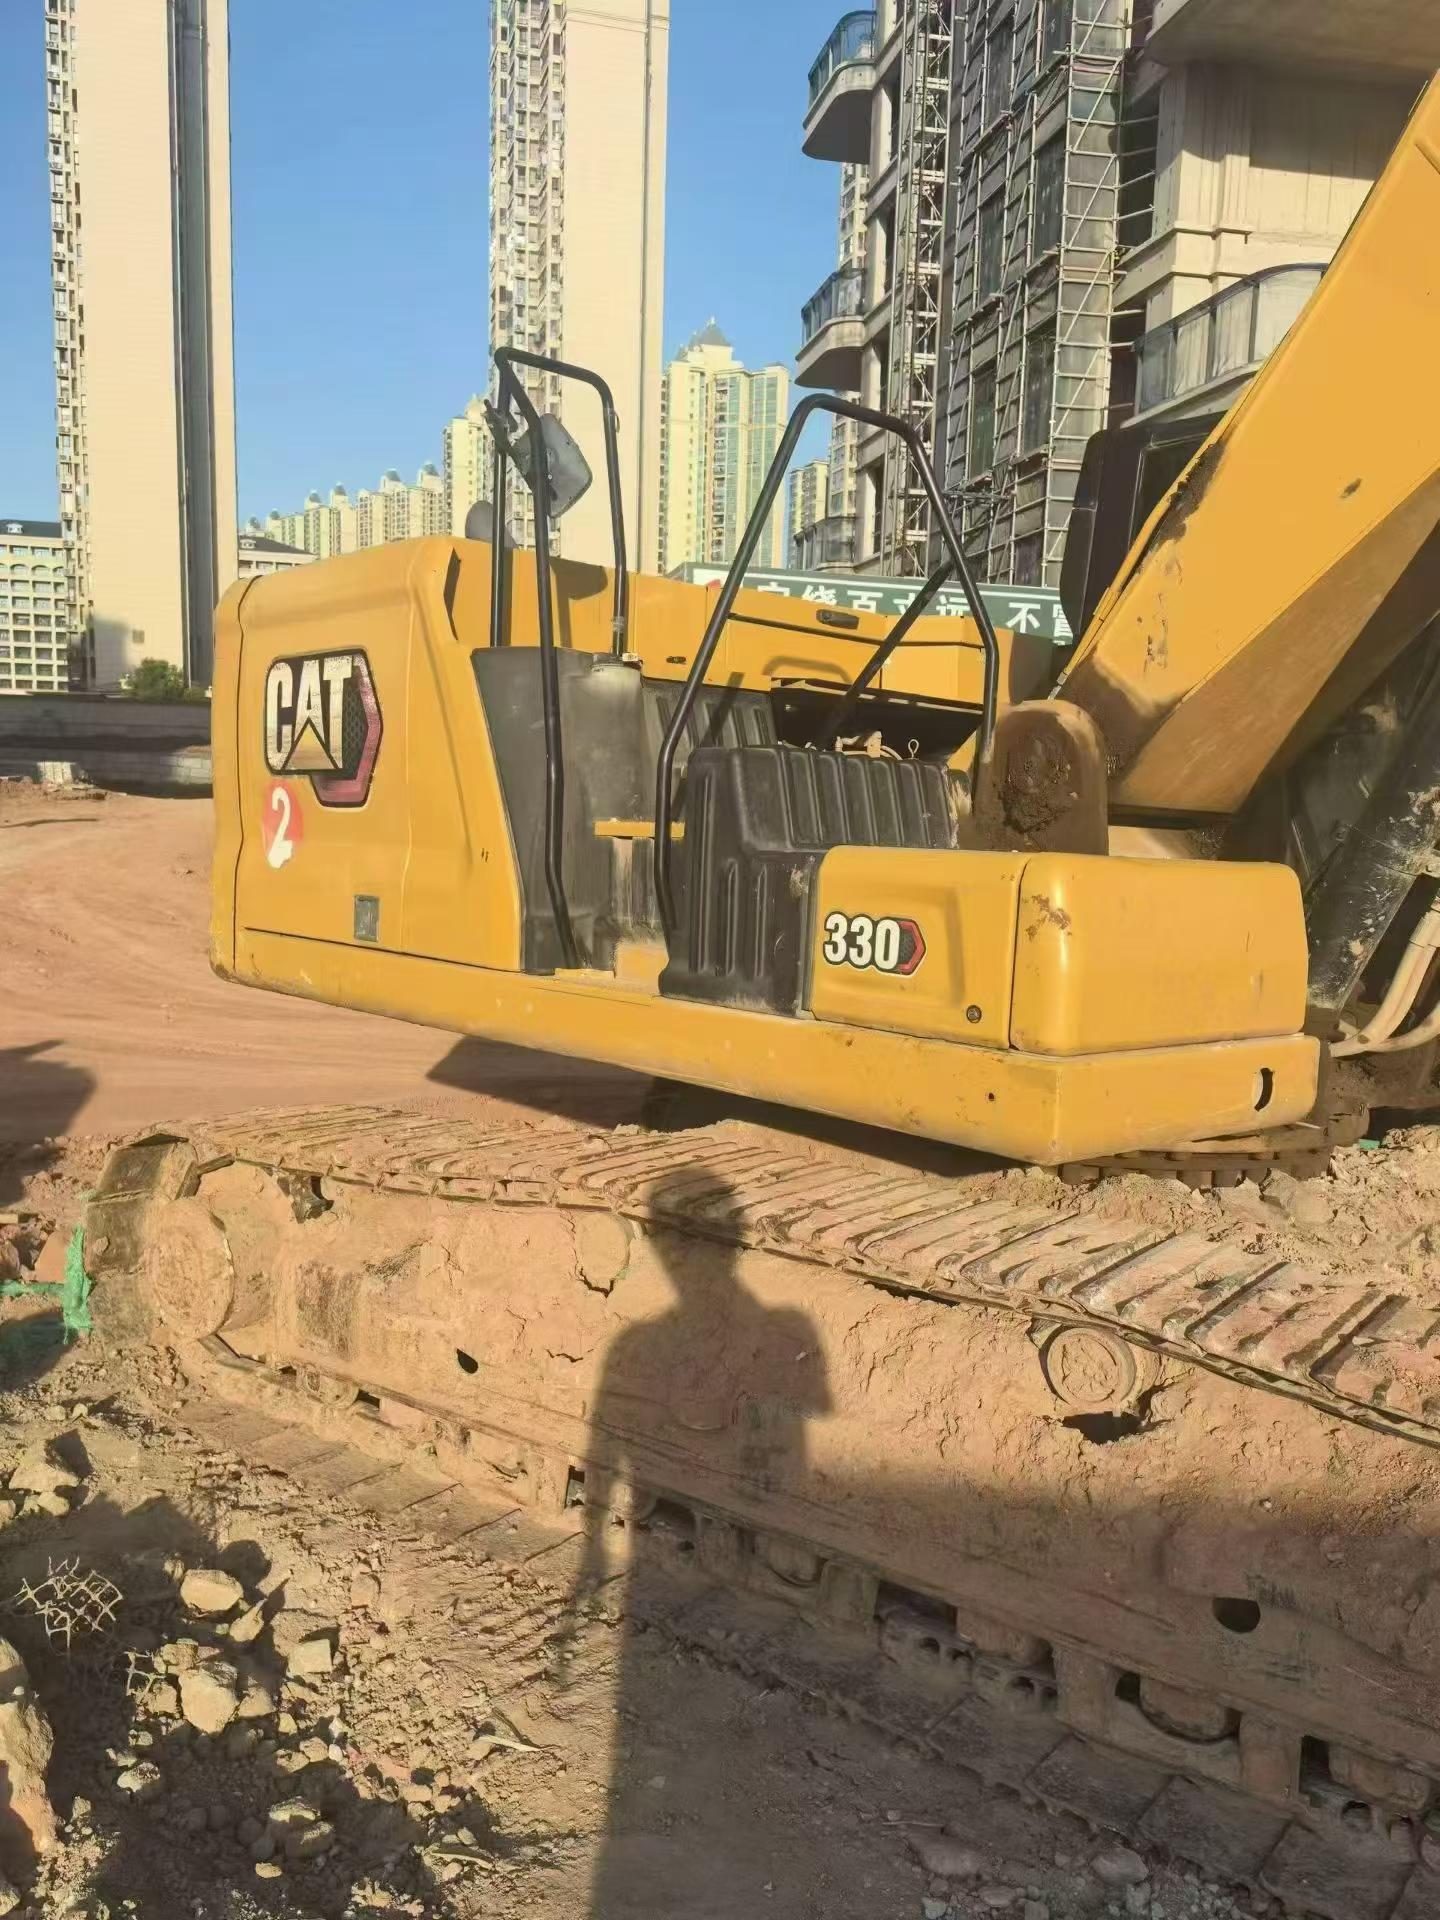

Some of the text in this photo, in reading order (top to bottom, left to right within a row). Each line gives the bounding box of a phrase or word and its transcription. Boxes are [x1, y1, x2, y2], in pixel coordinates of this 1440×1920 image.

[266, 655, 353, 770] CAT
[266, 786, 293, 869] 2
[824, 913, 901, 970] 330
